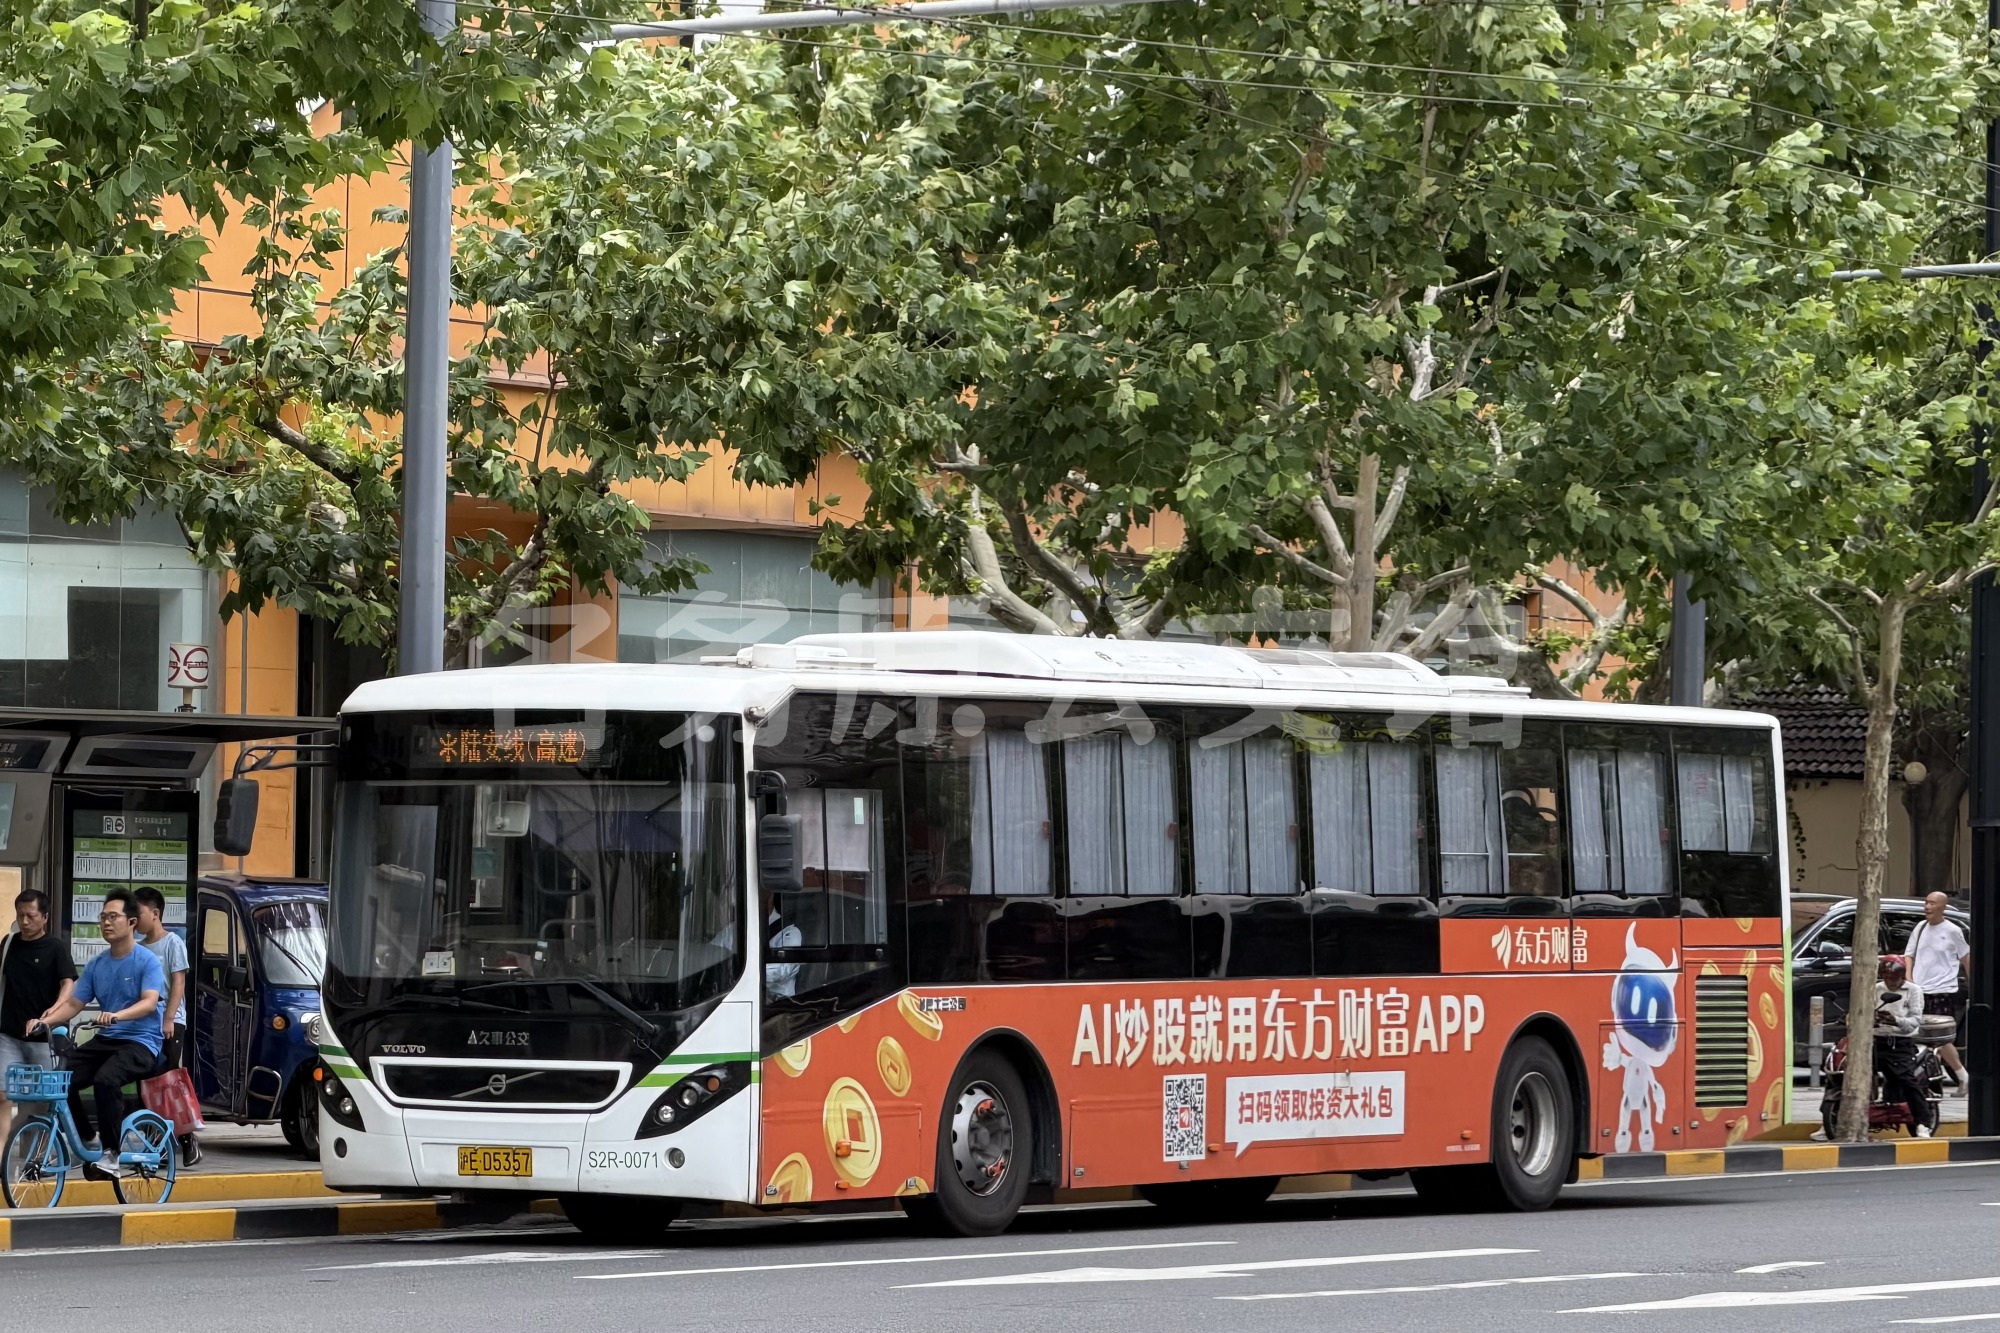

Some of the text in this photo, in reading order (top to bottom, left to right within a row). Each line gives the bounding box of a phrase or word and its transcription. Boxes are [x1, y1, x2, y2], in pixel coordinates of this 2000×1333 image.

[1514, 925, 1588, 965] 东方财富
[1071, 986, 1486, 1067] AI炒股就用东方财富APP
[381, 1044, 426, 1054] VOLVO
[1238, 1085, 1393, 1125] 扫码领取投资大礼包
[588, 1151, 658, 1169] S2R-0071
